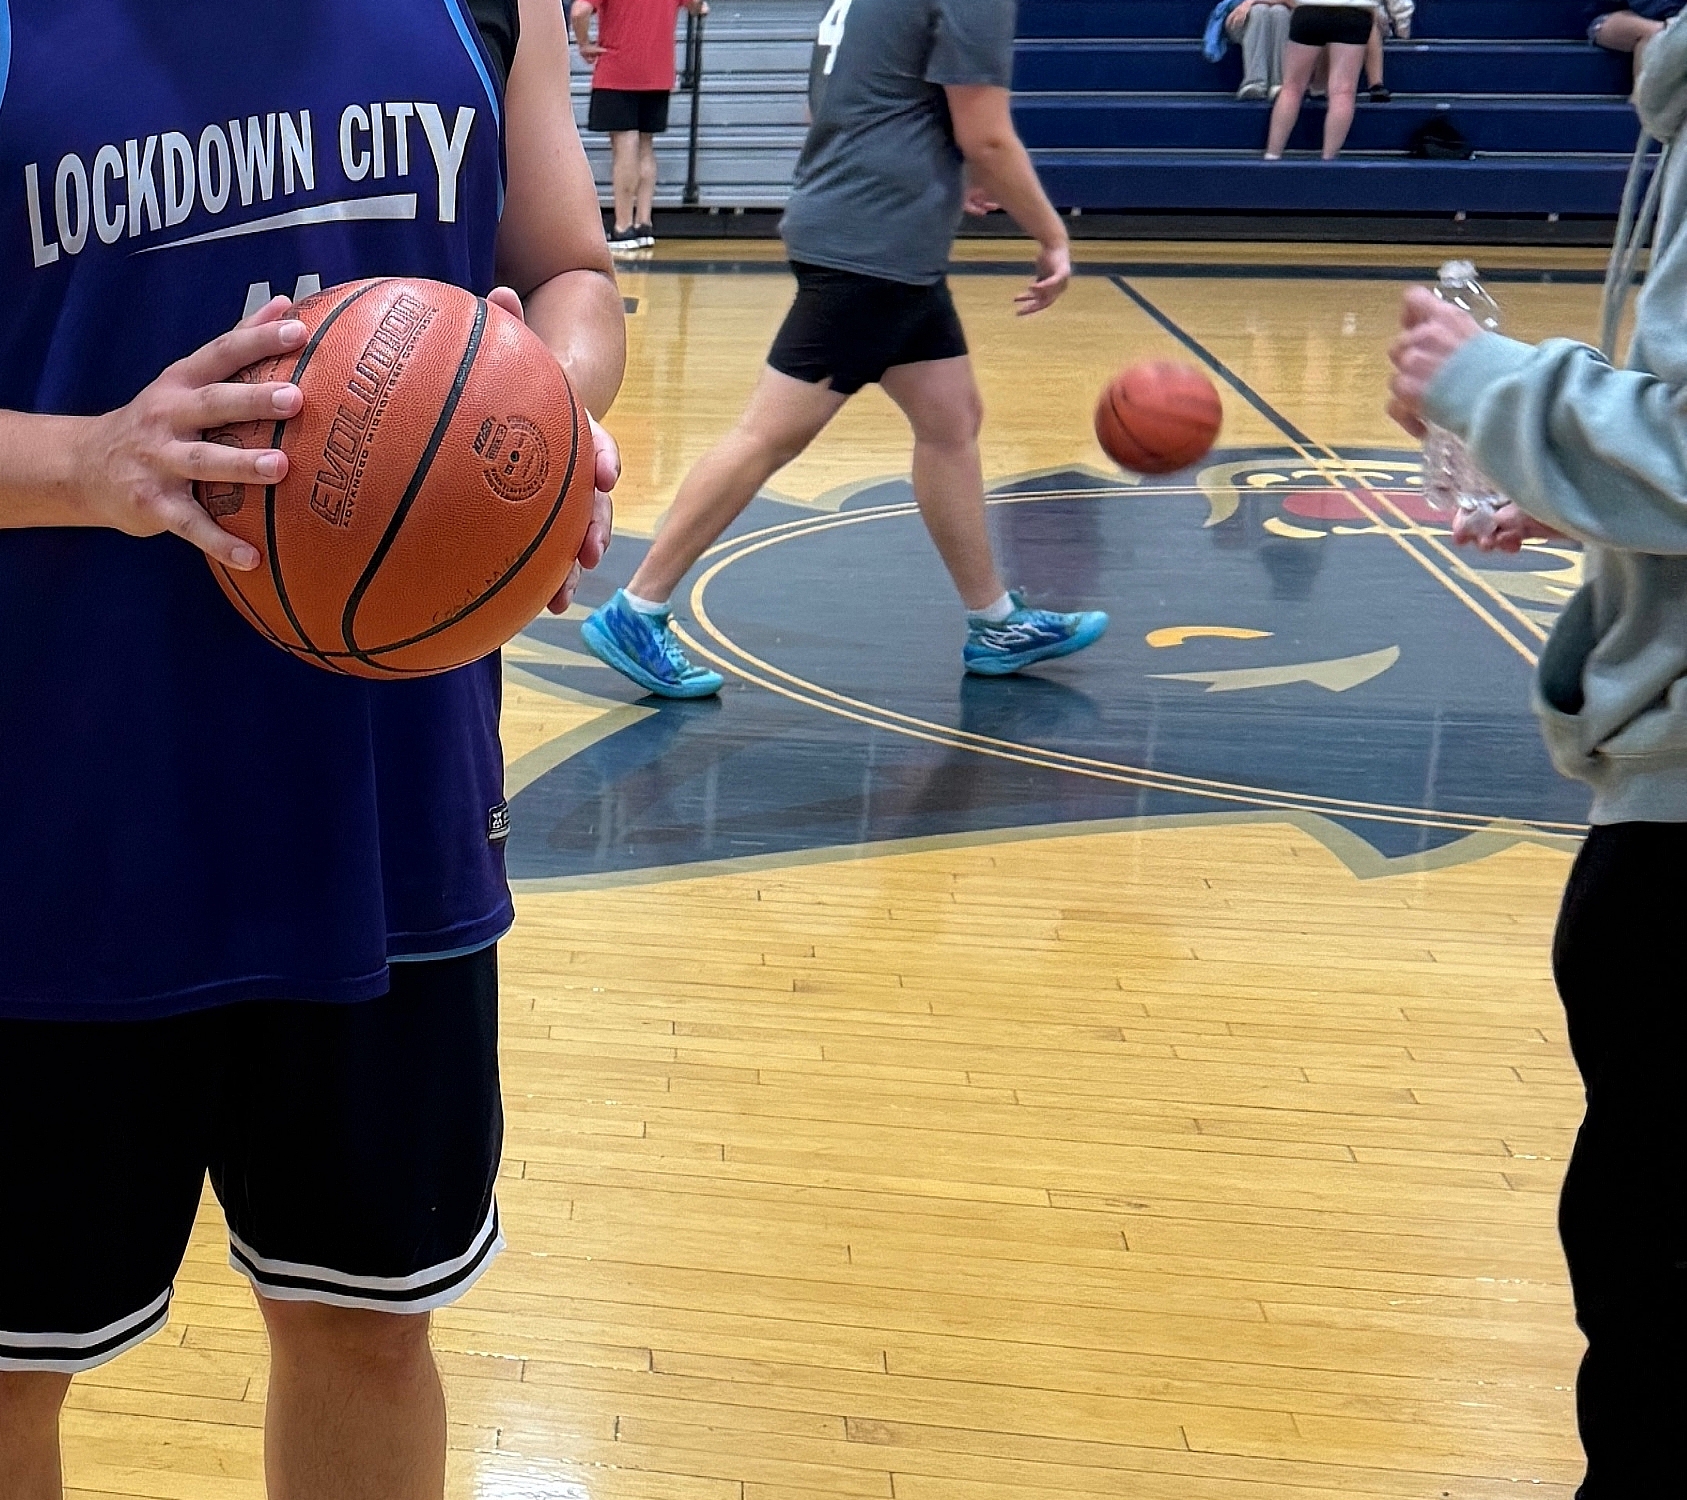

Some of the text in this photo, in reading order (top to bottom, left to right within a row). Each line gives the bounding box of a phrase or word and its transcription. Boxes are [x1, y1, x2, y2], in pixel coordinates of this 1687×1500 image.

[24, 102, 476, 268] LOCKDOWN CITY
[310, 293, 426, 526] EVOLUTION
